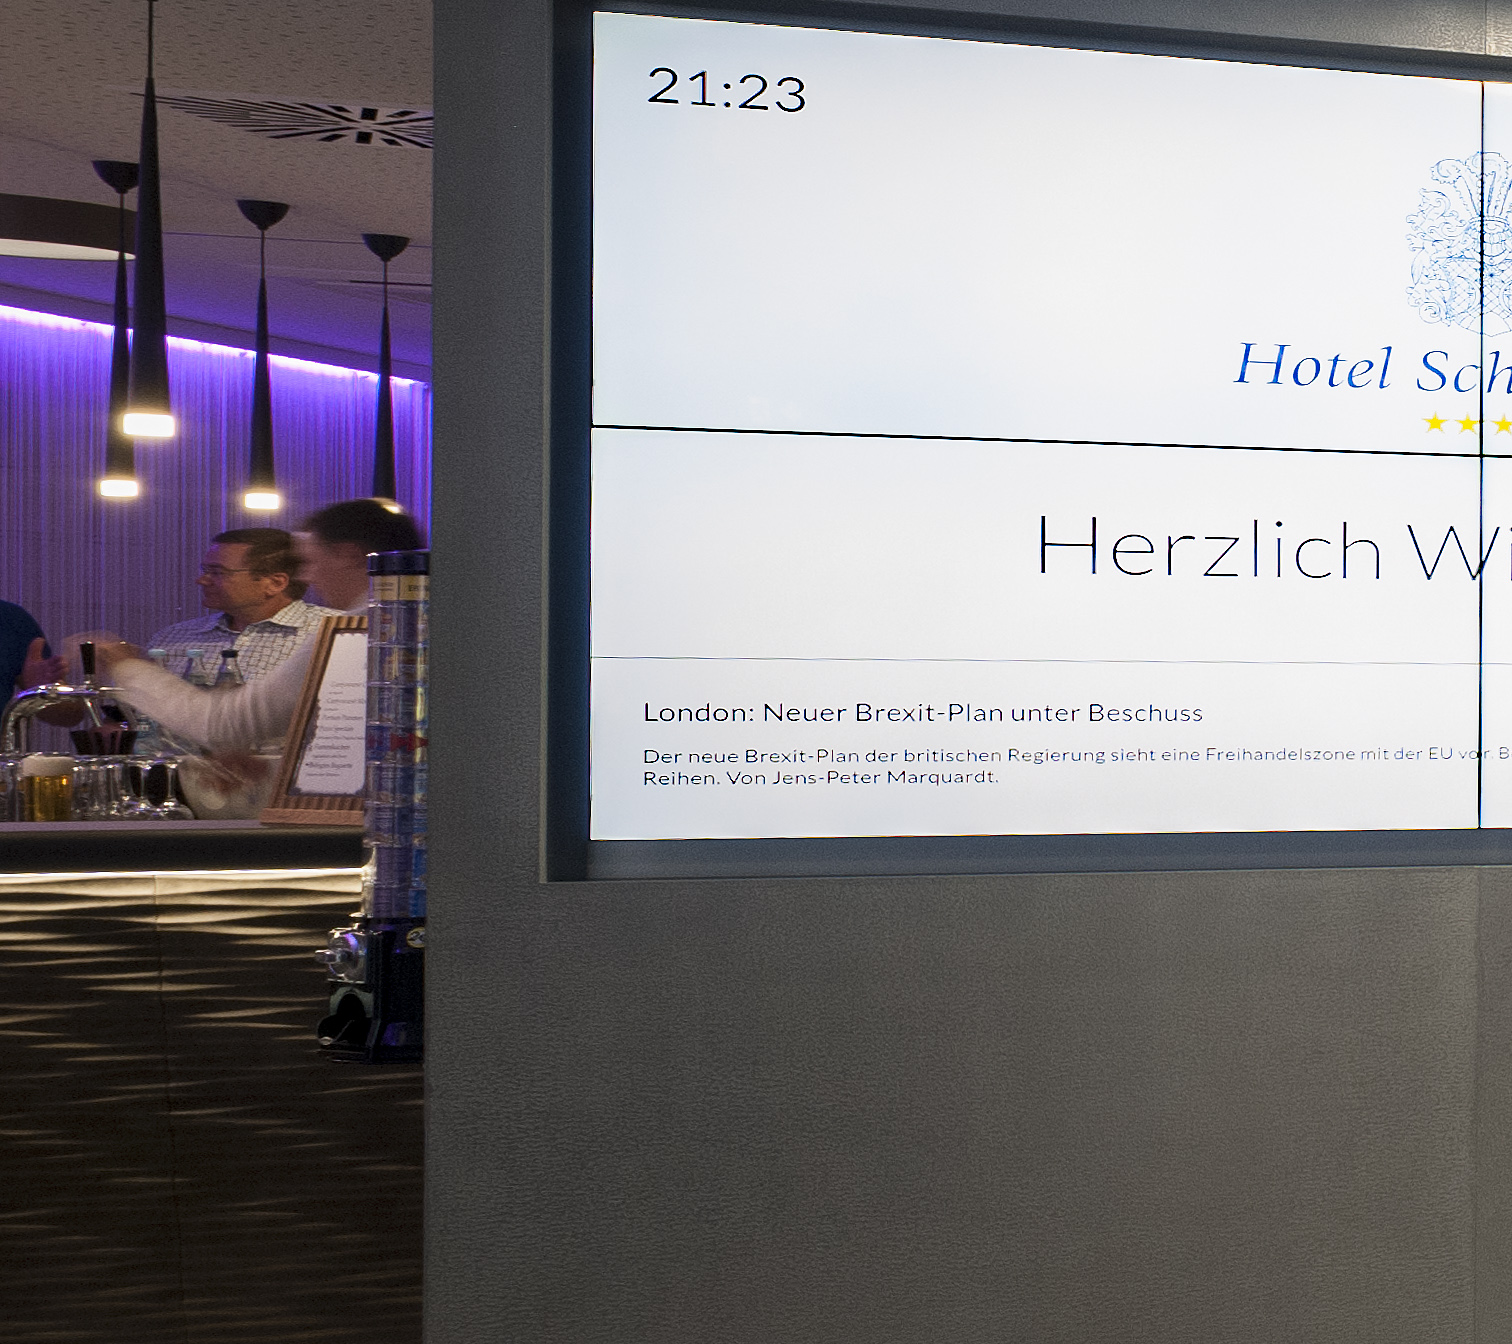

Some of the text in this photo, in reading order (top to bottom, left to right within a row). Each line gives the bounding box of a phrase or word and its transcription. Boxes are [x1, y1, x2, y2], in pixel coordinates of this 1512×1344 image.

[648, 68, 805, 112] 21:23
[1233, 343, 1392, 389] Hotel
[1041, 516, 1379, 579] Herzlich
[645, 703, 1202, 722] London: Neuer Brexit-Plan unter Beschuss
[643, 749, 683, 764] Der
[688, 752, 739, 764] neue
[745, 748, 859, 764] Brexit-Plan
[865, 749, 899, 763] der
[904, 748, 1002, 763] britischen
[1008, 748, 1106, 765] Regierung
[1110, 748, 1156, 762] sieht
[1161, 748, 1201, 761] eine
[1206, 747, 1356, 761] Freihandelszone
[1361, 747, 1389, 761] mit
[1393, 747, 1423, 760] der
[1429, 746, 1453, 760] EU
[643, 770, 999, 787] Reihen. Von Jens-Peter Marquardt.
